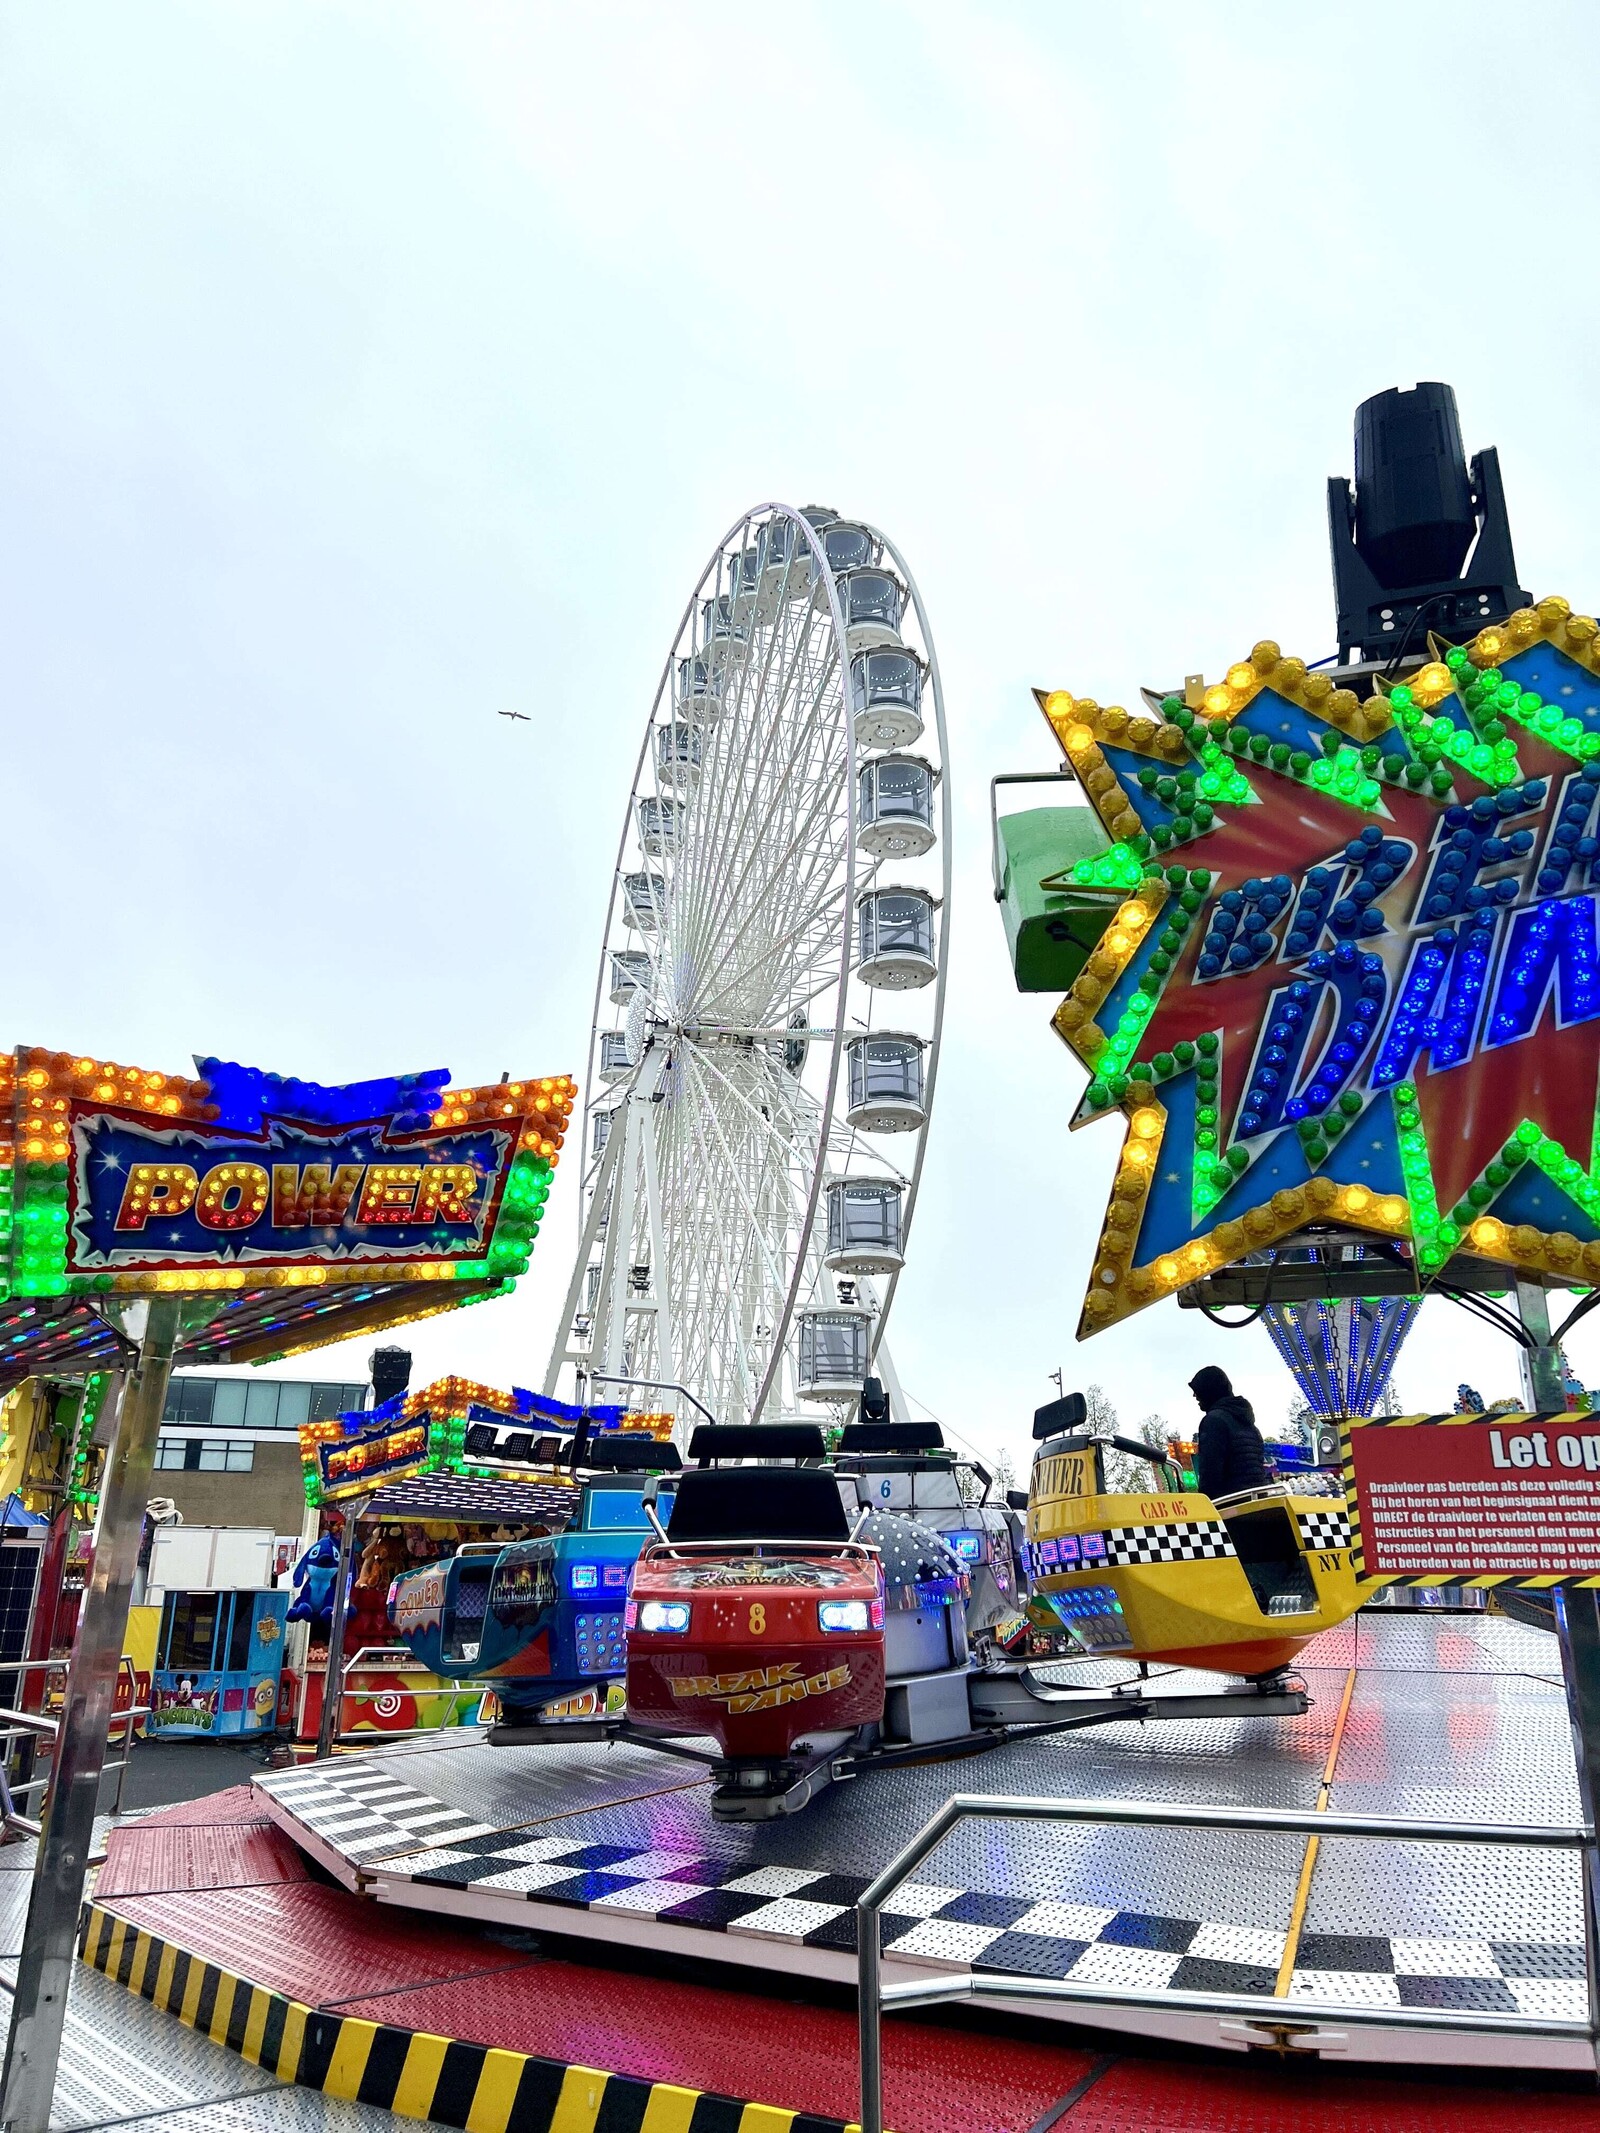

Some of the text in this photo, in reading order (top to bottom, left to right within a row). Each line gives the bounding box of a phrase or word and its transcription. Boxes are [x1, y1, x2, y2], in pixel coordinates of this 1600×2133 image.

[114, 1162, 480, 1232] POWER
[328, 1425, 426, 1479] POWER
[1489, 1430, 1552, 1469] Let
[880, 1479, 892, 1498] 6
[1369, 1481, 1425, 1493] Draaivloer
[1426, 1483, 1447, 1493] pas
[1448, 1481, 1499, 1492] betreden
[1500, 1480, 1518, 1492] als
[1520, 1480, 1546, 1491] deze
[1547, 1480, 1594, 1492] volledig
[1141, 1500, 1188, 1519] CAB 05
[1371, 1497, 1386, 1509] Bij
[1388, 1496, 1406, 1508] het
[1407, 1496, 1440, 1508] horen
[1441, 1498, 1461, 1507] van
[1462, 1496, 1482, 1507] het
[1482, 1495, 1557, 1508] beginsignaal
[1558, 1495, 1589, 1506] dient
[1372, 1512, 1410, 1523] DIRECT
[1411, 1512, 1425, 1523] de
[1427, 1511, 1484, 1522] draaivloer
[1485, 1511, 1497, 1522] te
[1498, 1510, 1546, 1522] verlaten
[1548, 1512, 1563, 1522] en
[1375, 1527, 1434, 1538] Instructies
[1436, 1528, 1456, 1538] van
[1457, 1526, 1477, 1537] het
[1478, 1526, 1535, 1538] personeel
[1537, 1526, 1567, 1537] dient
[1568, 1527, 1594, 1537] men
[1376, 1542, 1432, 1553] Personeel
[1433, 1543, 1454, 1553] van
[1455, 1542, 1470, 1553] de
[1471, 1541, 1539, 1553] breakdance
[1540, 1543, 1566, 1554] mag
[1567, 1543, 1575, 1553] u
[1317, 1553, 1342, 1573] NY
[1378, 1557, 1397, 1568] Het
[1398, 1557, 1449, 1568] betreden
[1450, 1558, 1471, 1568] van
[1472, 1557, 1487, 1568] de
[1488, 1557, 1538, 1568] attractie
[1539, 1557, 1550, 1568] is
[1553, 1558, 1567, 1570] op
[398, 1579, 439, 1625] POWER
[749, 1603, 766, 1635] 8
[665, 1663, 806, 1696] BREAK
[710, 1664, 853, 1714] DANCE
[153, 1707, 214, 1730] TICKETS
